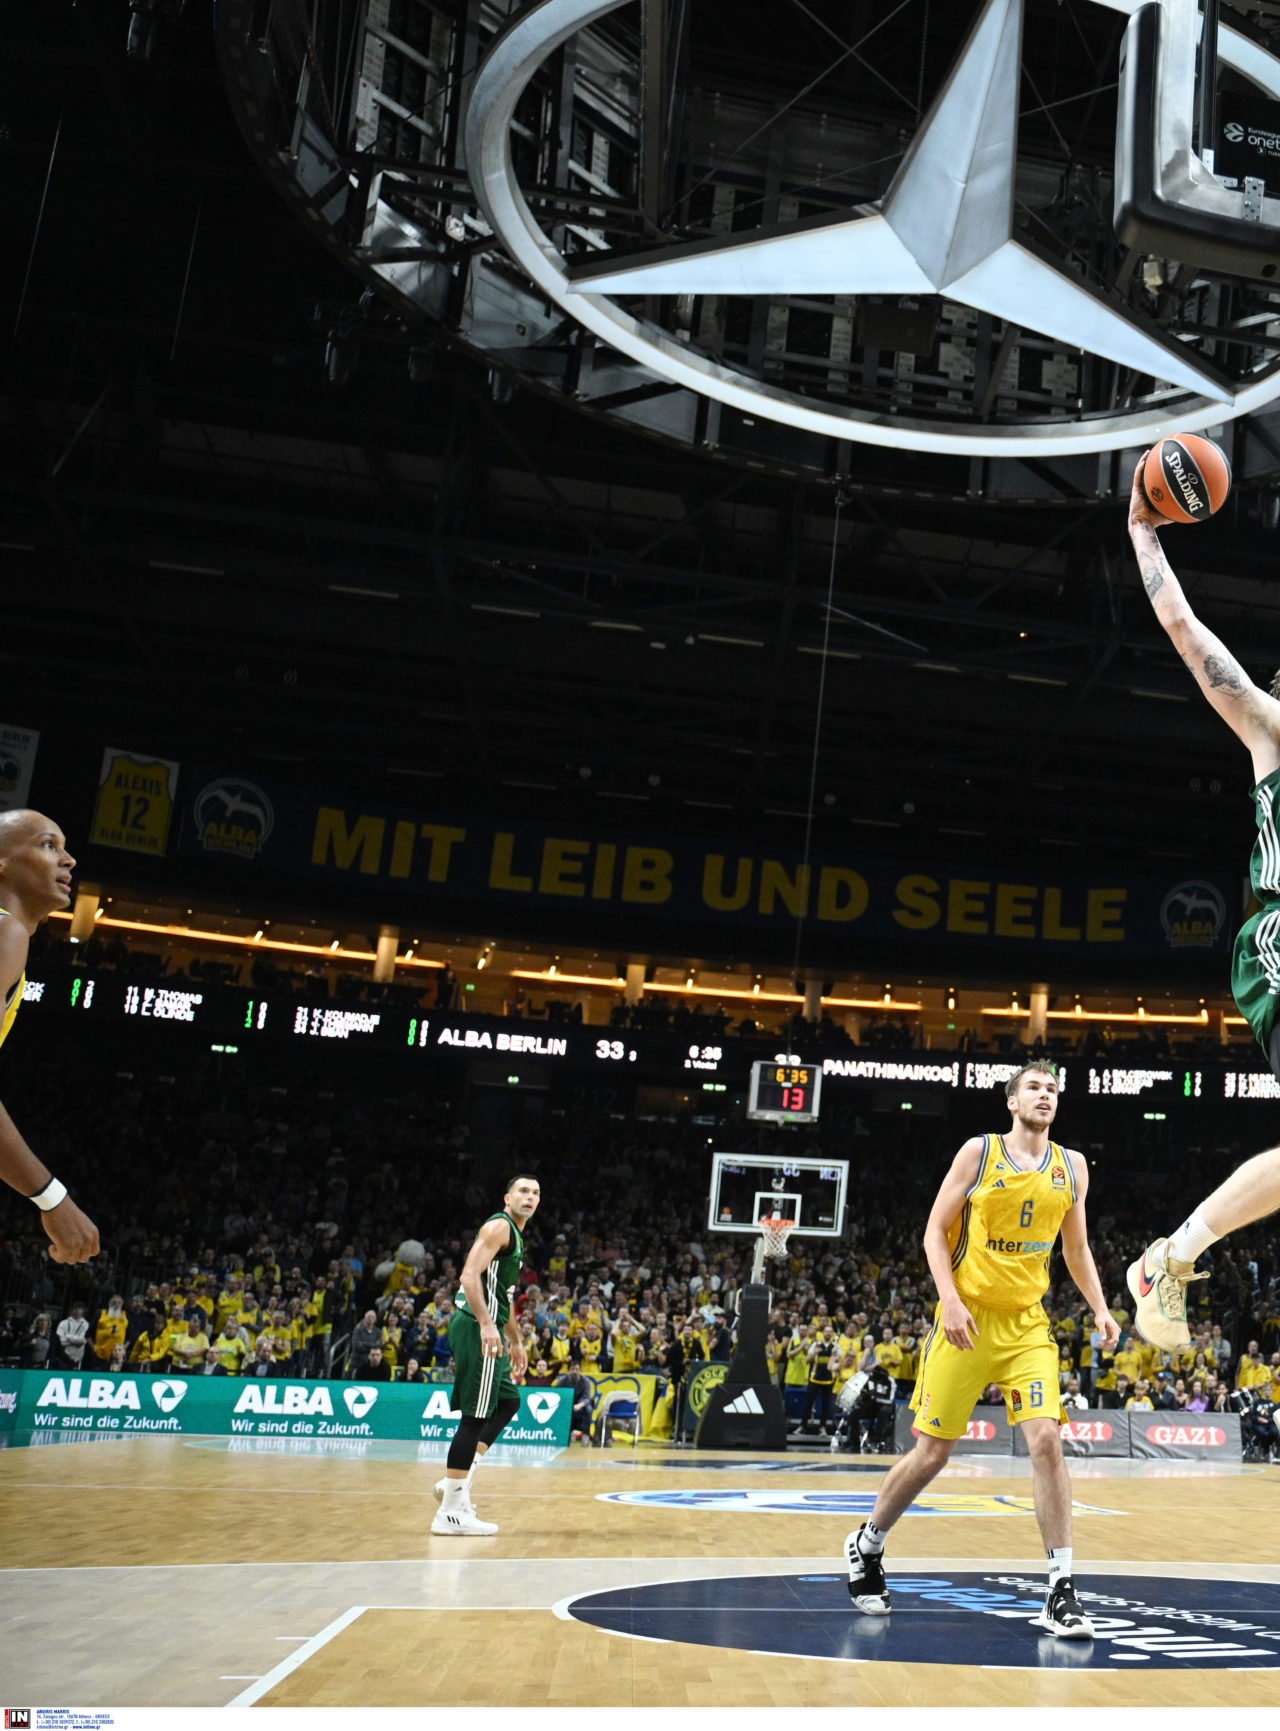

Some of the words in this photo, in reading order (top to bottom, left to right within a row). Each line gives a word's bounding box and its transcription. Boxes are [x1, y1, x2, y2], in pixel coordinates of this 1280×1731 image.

[1165, 450, 1204, 514] SPALDING
[114, 771, 163, 796] ALEXIS
[120, 794, 151, 830] 12
[203, 820, 259, 844] ALBA
[311, 806, 466, 883] MIT
[487, 832, 674, 904] LEIB
[702, 853, 869, 923] UND
[891, 875, 1128, 943] SEELE
[1172, 921, 1214, 937] ALBA
[438, 1028, 493, 1049] ALBA
[496, 1033, 567, 1056] BERLIN
[596, 1039, 624, 1059] 33
[822, 1059, 952, 1082] PANATHINAIKOS
[781, 1087, 805, 1110] 13
[1020, 1200, 1034, 1228] 6
[984, 1237, 1054, 1253] nterzer
[37, 1378, 141, 1410] ALBA
[233, 1384, 334, 1416] ALBA
[1030, 1381, 1043, 1408] 6
[34, 1413, 58, 1427] Wir
[61, 1414, 92, 1428] sind
[97, 1415, 119, 1429] die
[123, 1416, 182, 1431] Zukunft.
[231, 1418, 255, 1433] Wir
[258, 1419, 288, 1434] sind
[292, 1420, 313, 1435] die
[317, 1422, 374, 1436] Zukunft.
[420, 1424, 443, 1438] Wir
[502, 1426, 557, 1441] Zukunft.
[1130, 1606, 1268, 1631] waste
